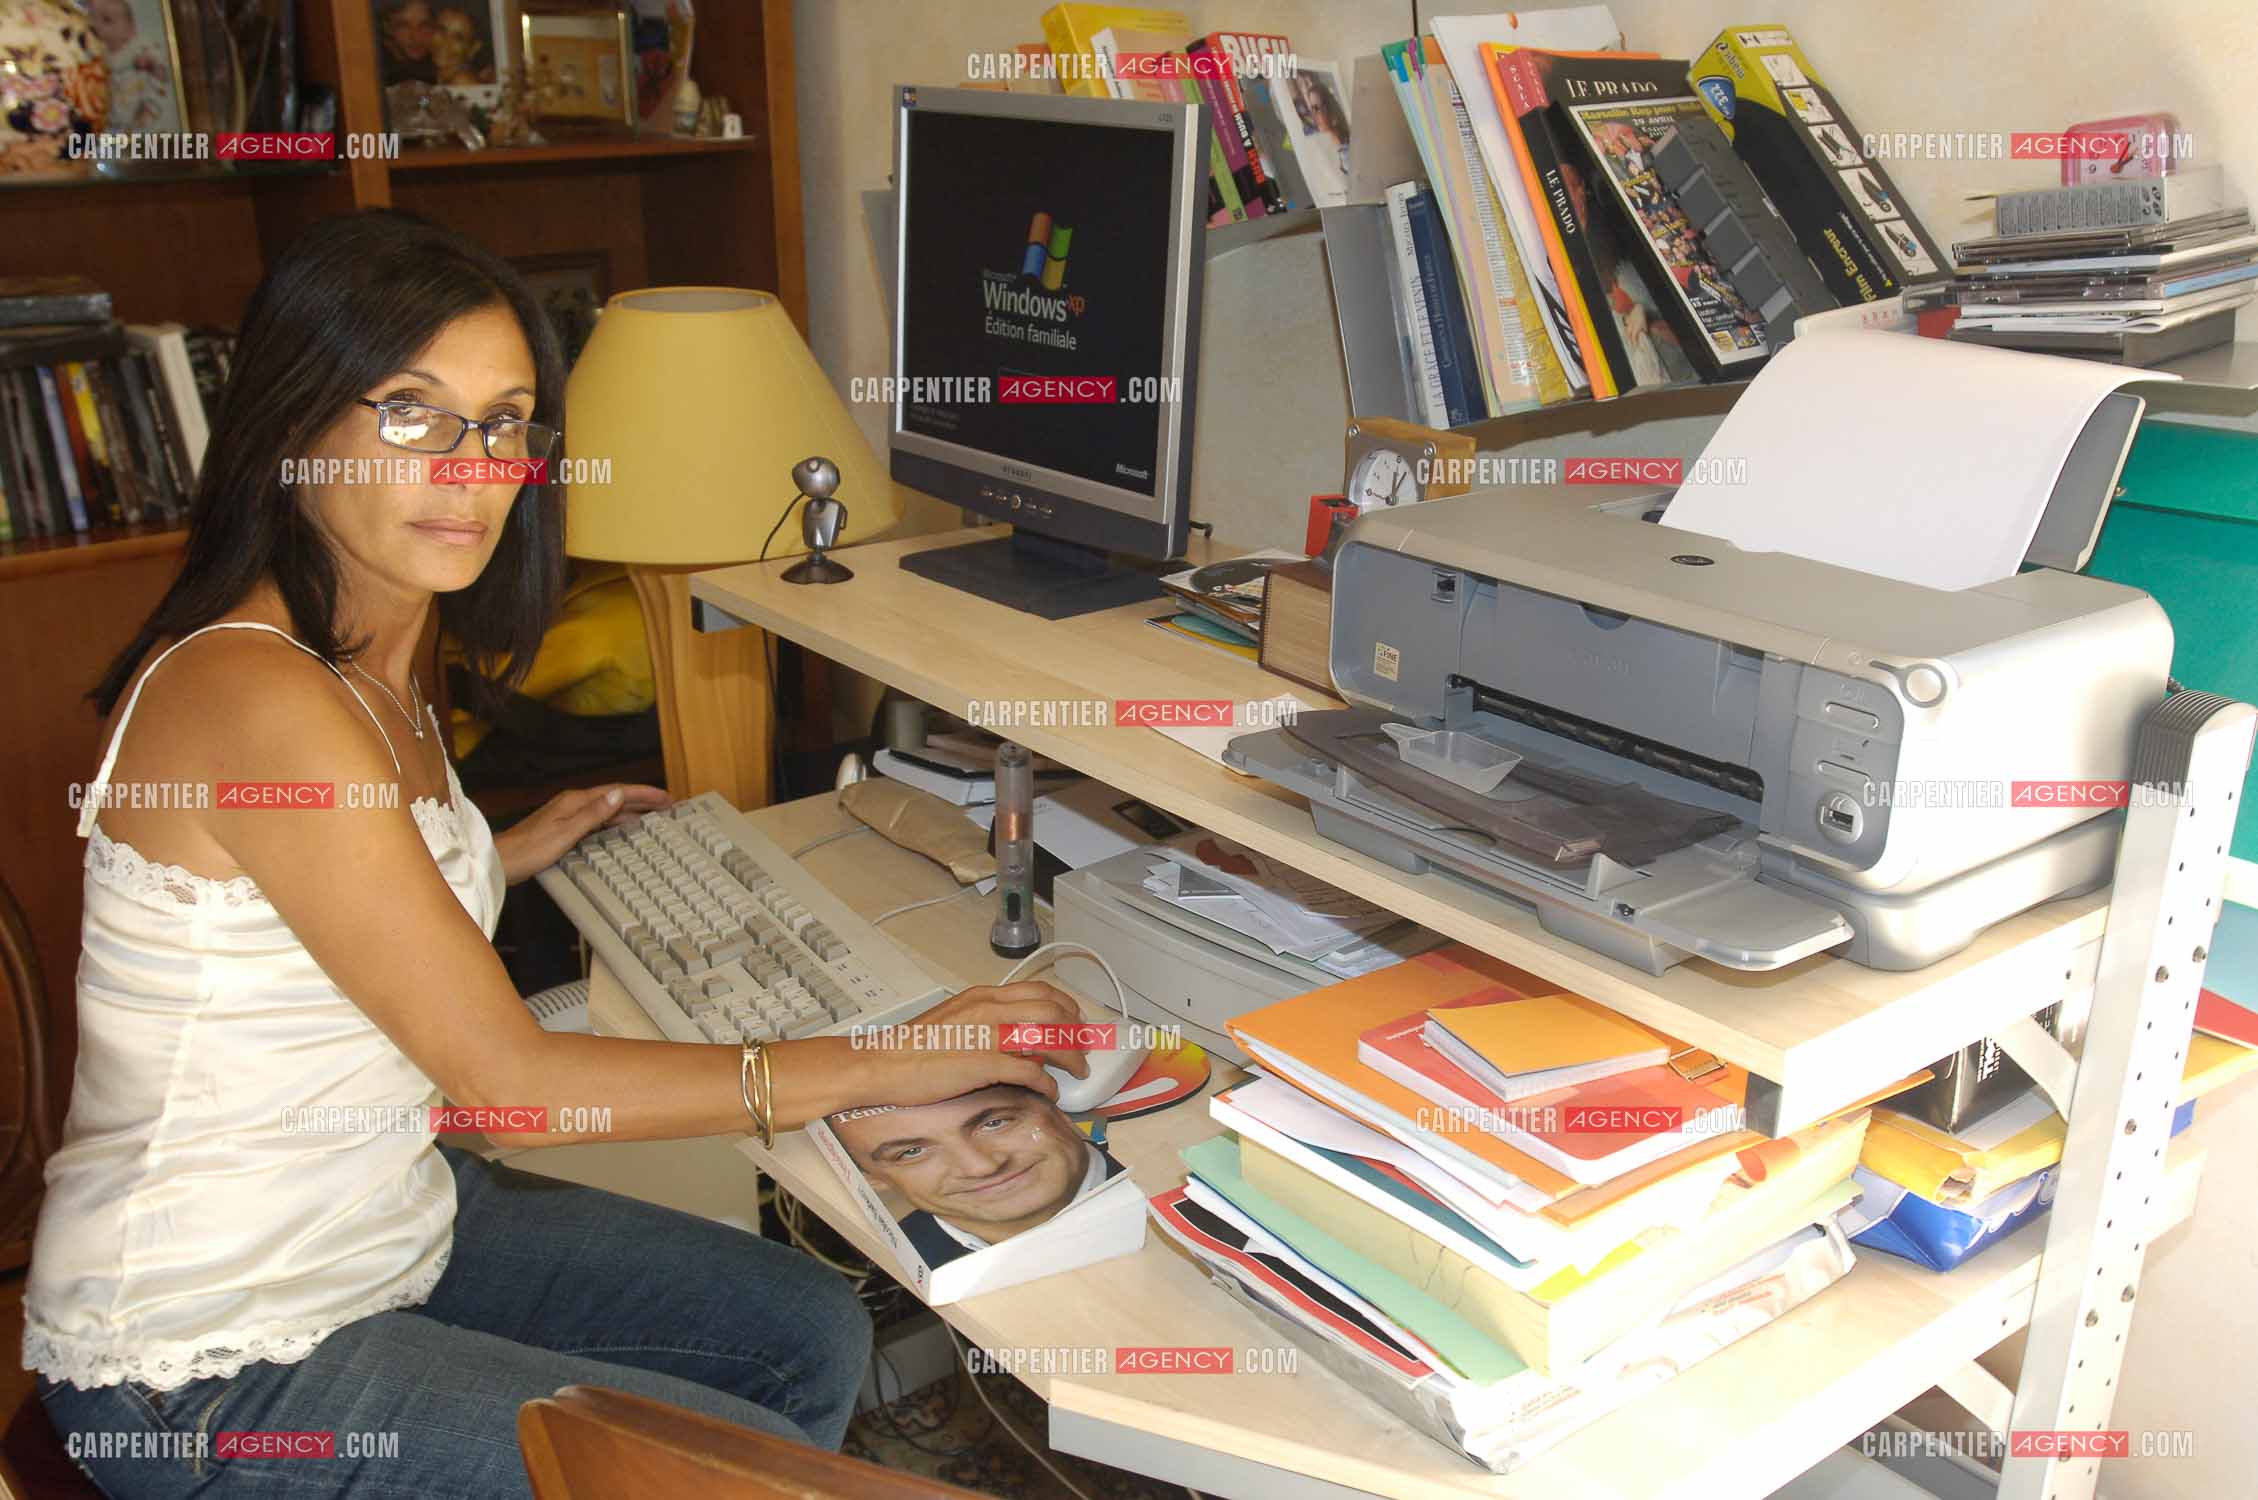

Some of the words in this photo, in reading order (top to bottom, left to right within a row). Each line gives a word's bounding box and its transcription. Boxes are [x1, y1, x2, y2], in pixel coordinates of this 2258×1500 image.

[1566, 78, 1588, 98] LE
[1594, 80, 1658, 97] PRADO
[1544, 169, 1559, 187] LE
[1553, 186, 1577, 234] PRADO
[1823, 228, 1859, 277] Encreur
[983, 279, 1067, 322] Windows
[1067, 294, 1085, 318] xp
[1856, 274, 1878, 303] Film
[985, 308, 1025, 340] Édition
[1027, 323, 1077, 350] familiale
